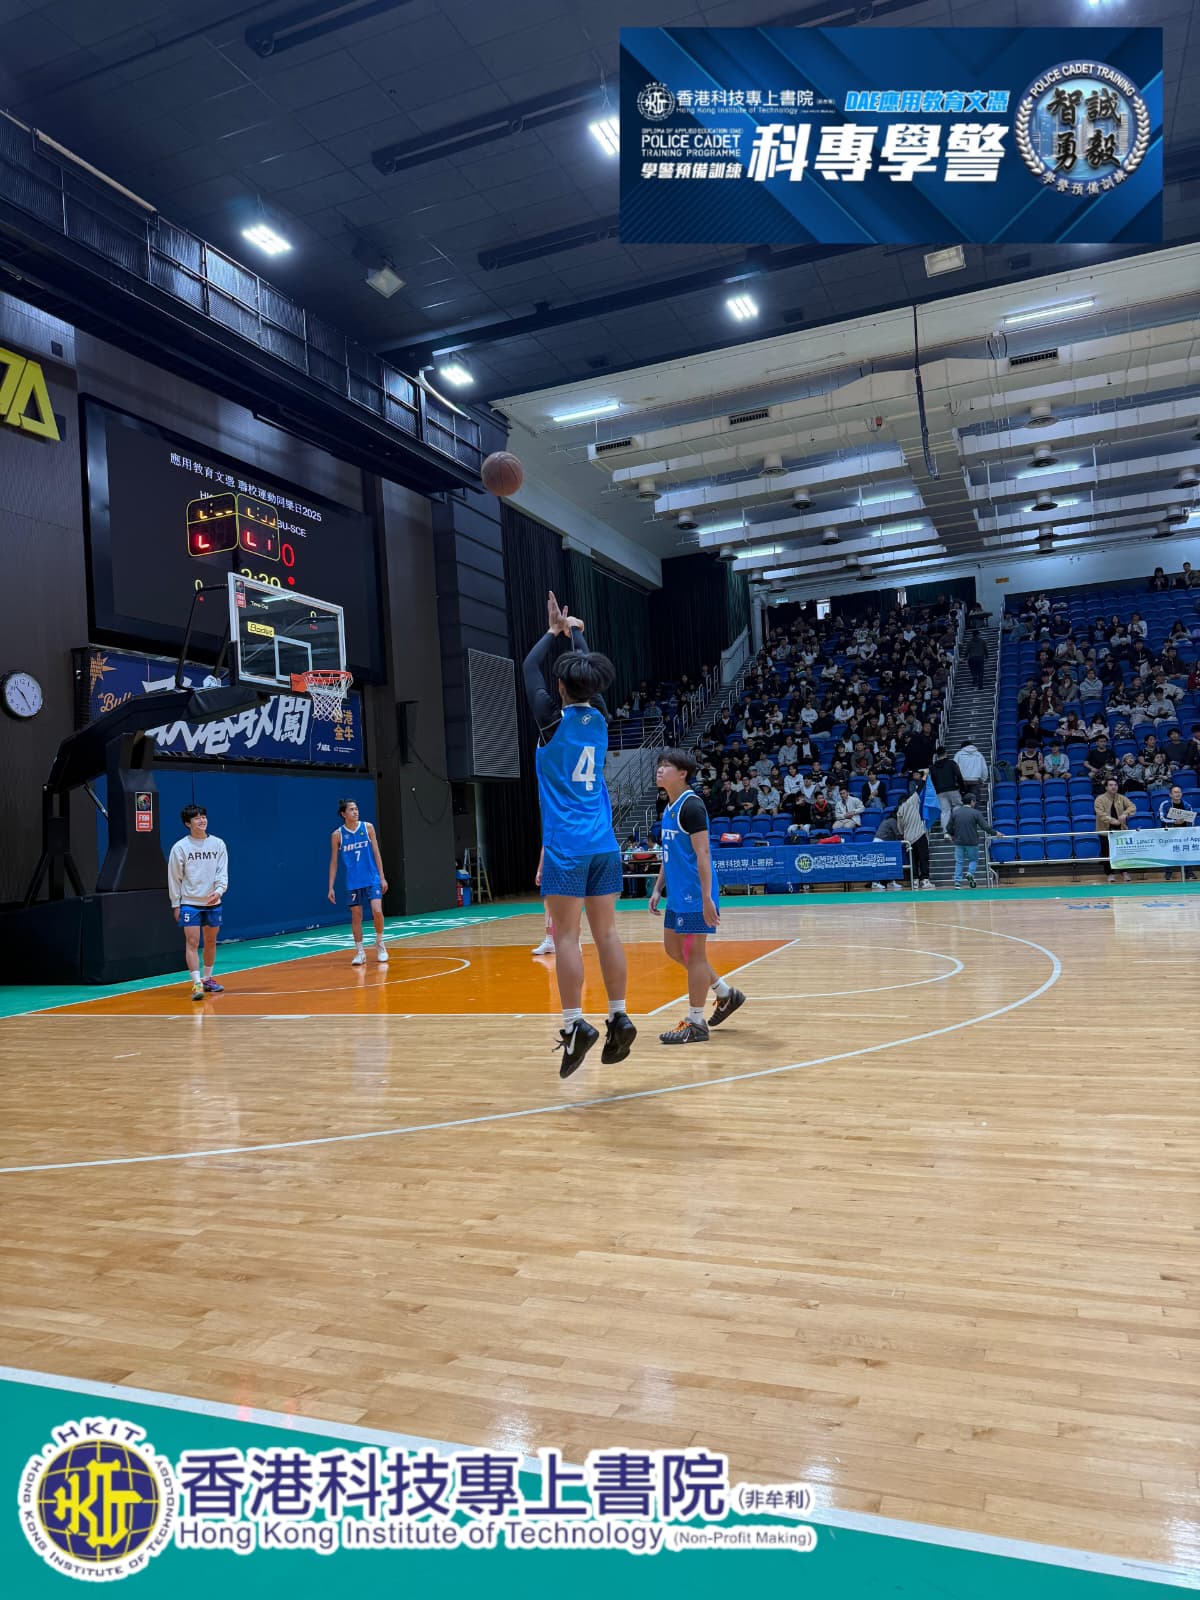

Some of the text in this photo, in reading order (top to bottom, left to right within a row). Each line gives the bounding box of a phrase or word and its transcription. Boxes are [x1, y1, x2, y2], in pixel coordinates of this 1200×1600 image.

[571, 746, 596, 791] 4
[187, 851, 218, 861] ARMY
[355, 850, 361, 862] 7
[184, 913, 190, 922] 5
